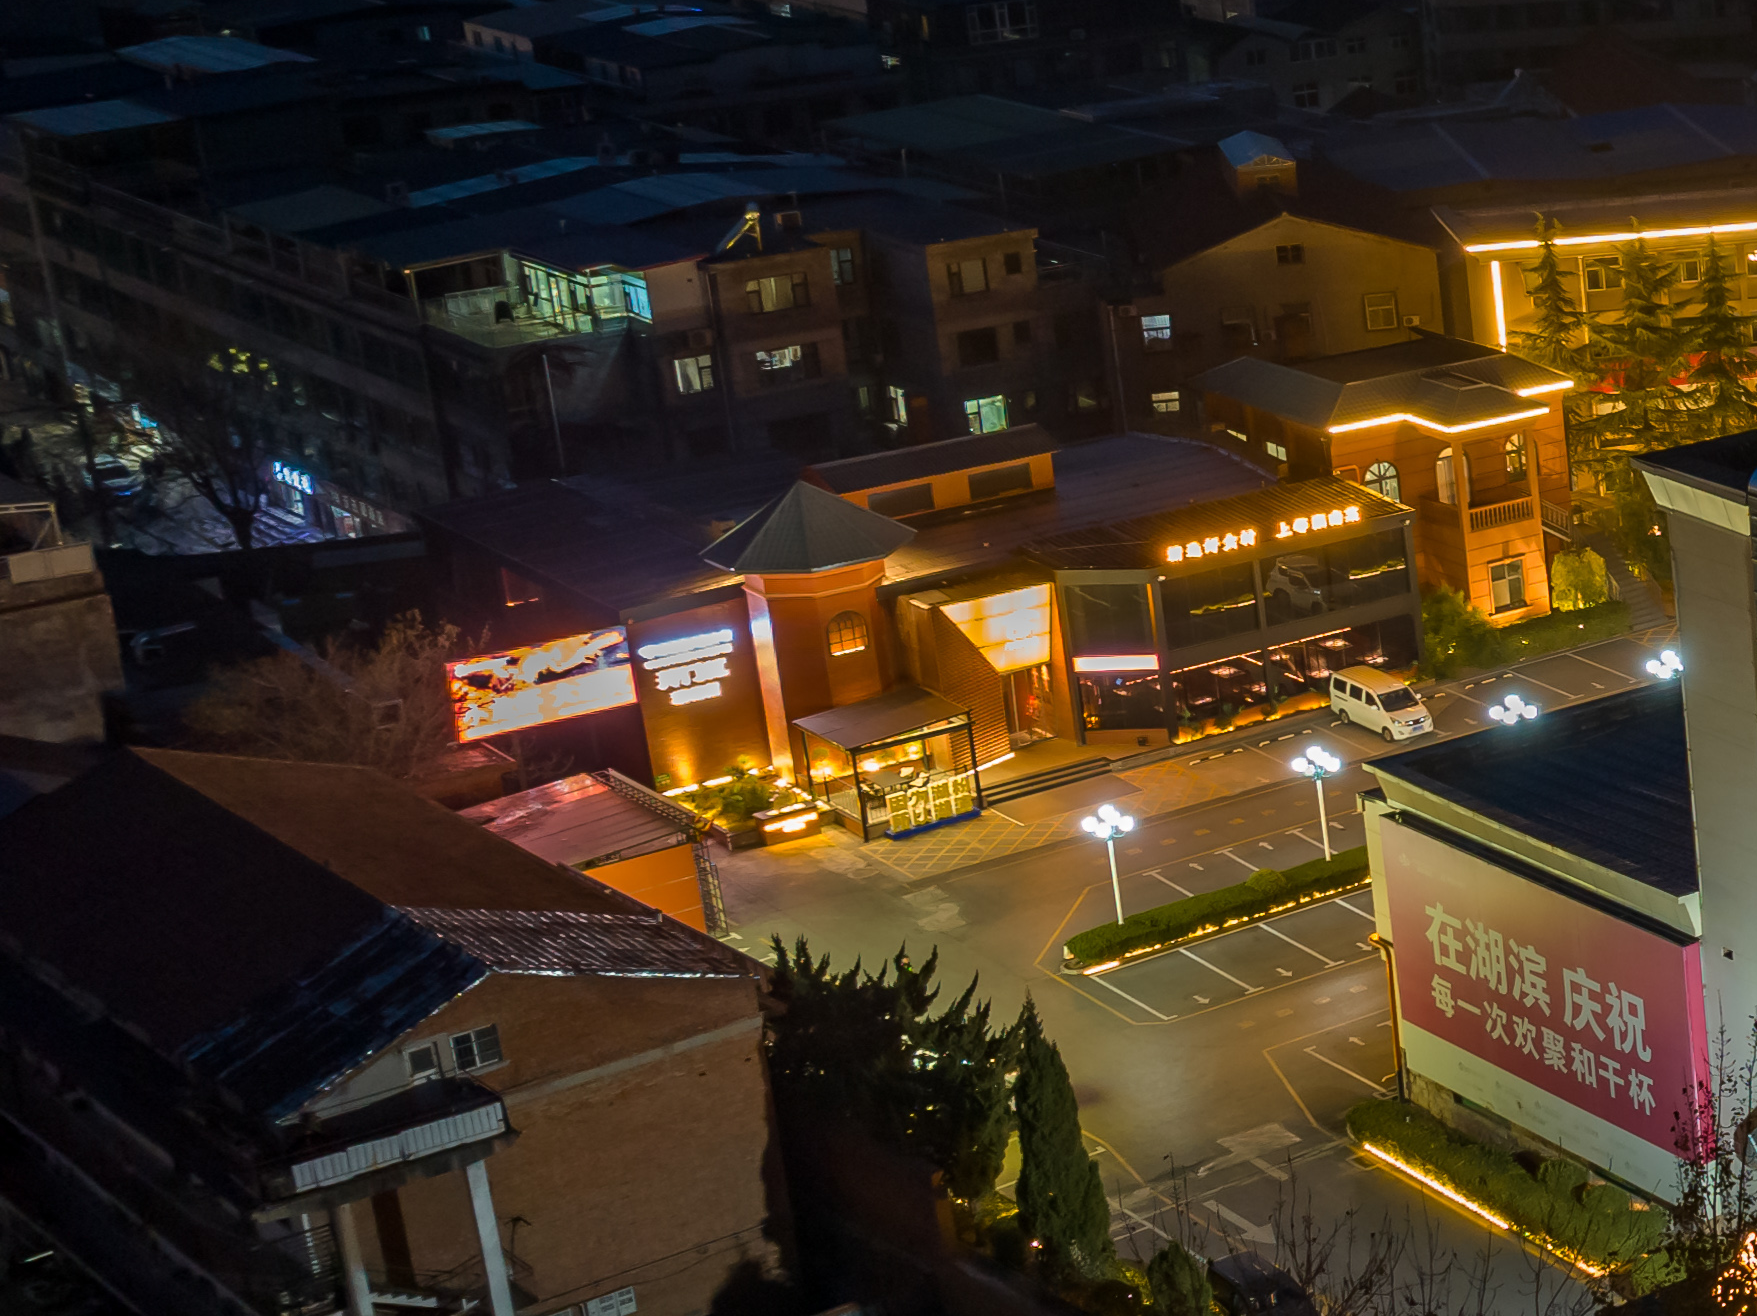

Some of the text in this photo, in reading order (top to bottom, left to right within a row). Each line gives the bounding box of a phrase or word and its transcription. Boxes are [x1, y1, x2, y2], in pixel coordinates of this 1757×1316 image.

[1425, 902, 1652, 1063] 在湖滨 庆祝
[1431, 974, 1656, 1116] 每一次欢聚和干杯
